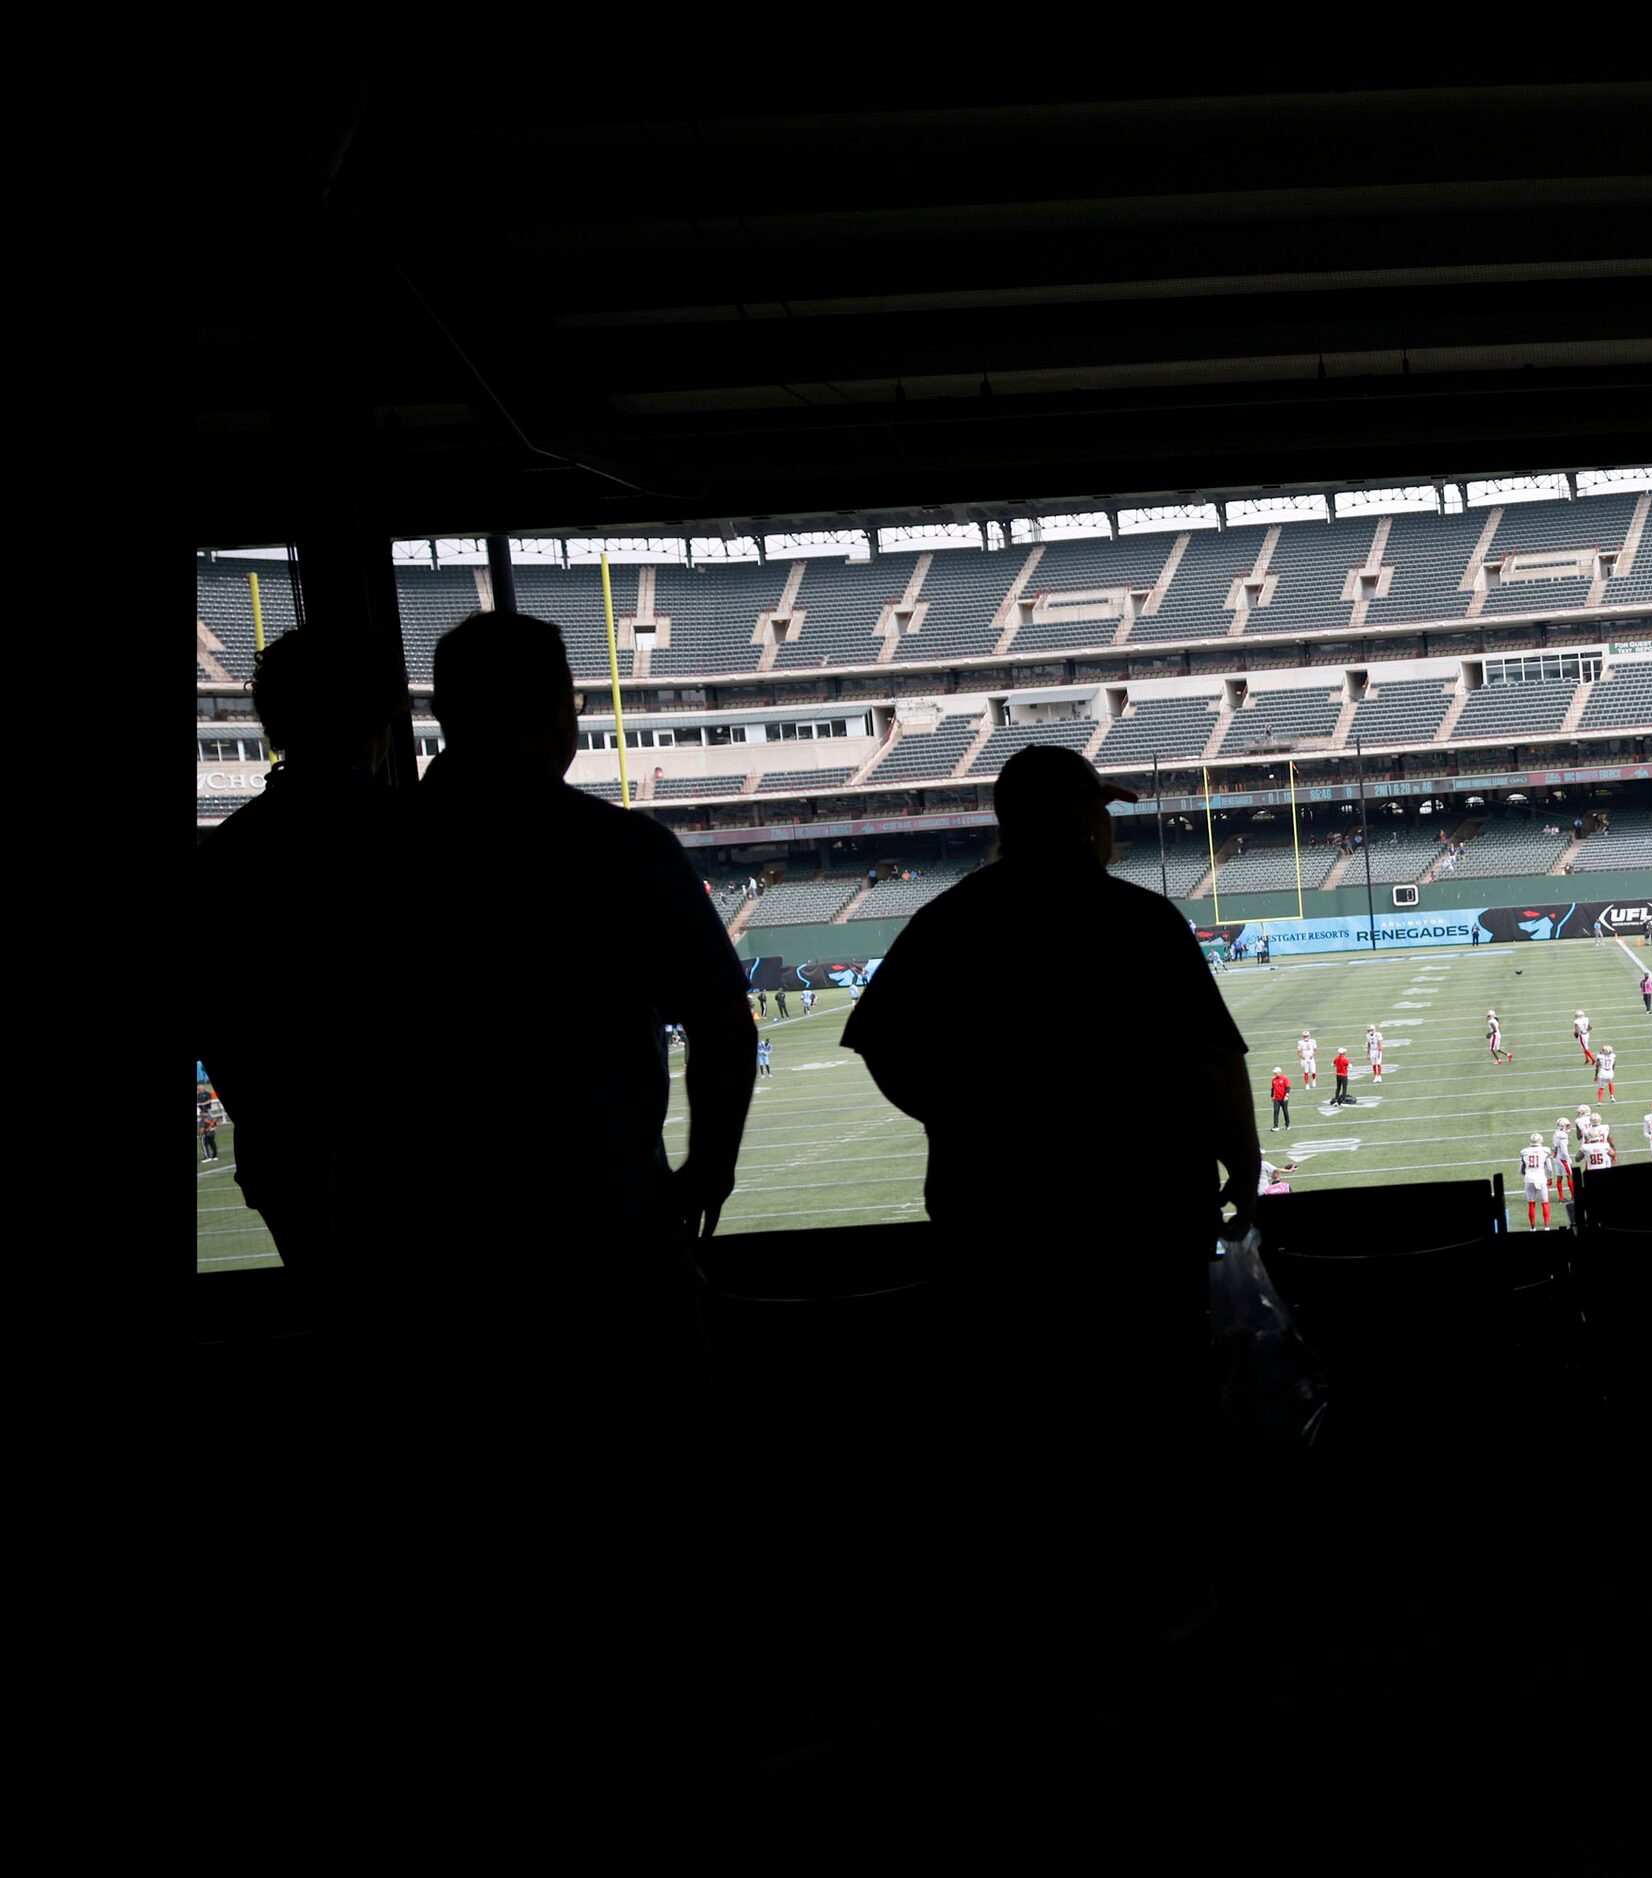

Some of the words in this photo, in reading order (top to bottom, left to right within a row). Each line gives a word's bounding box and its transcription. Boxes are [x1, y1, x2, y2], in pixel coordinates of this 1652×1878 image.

[206, 772, 268, 789] CHO
[1610, 907, 1652, 922] UFL
[1308, 930, 1350, 940] RESORTS
[1356, 925, 1470, 941] RENEGADES
[1590, 1153, 1603, 1165] 85
